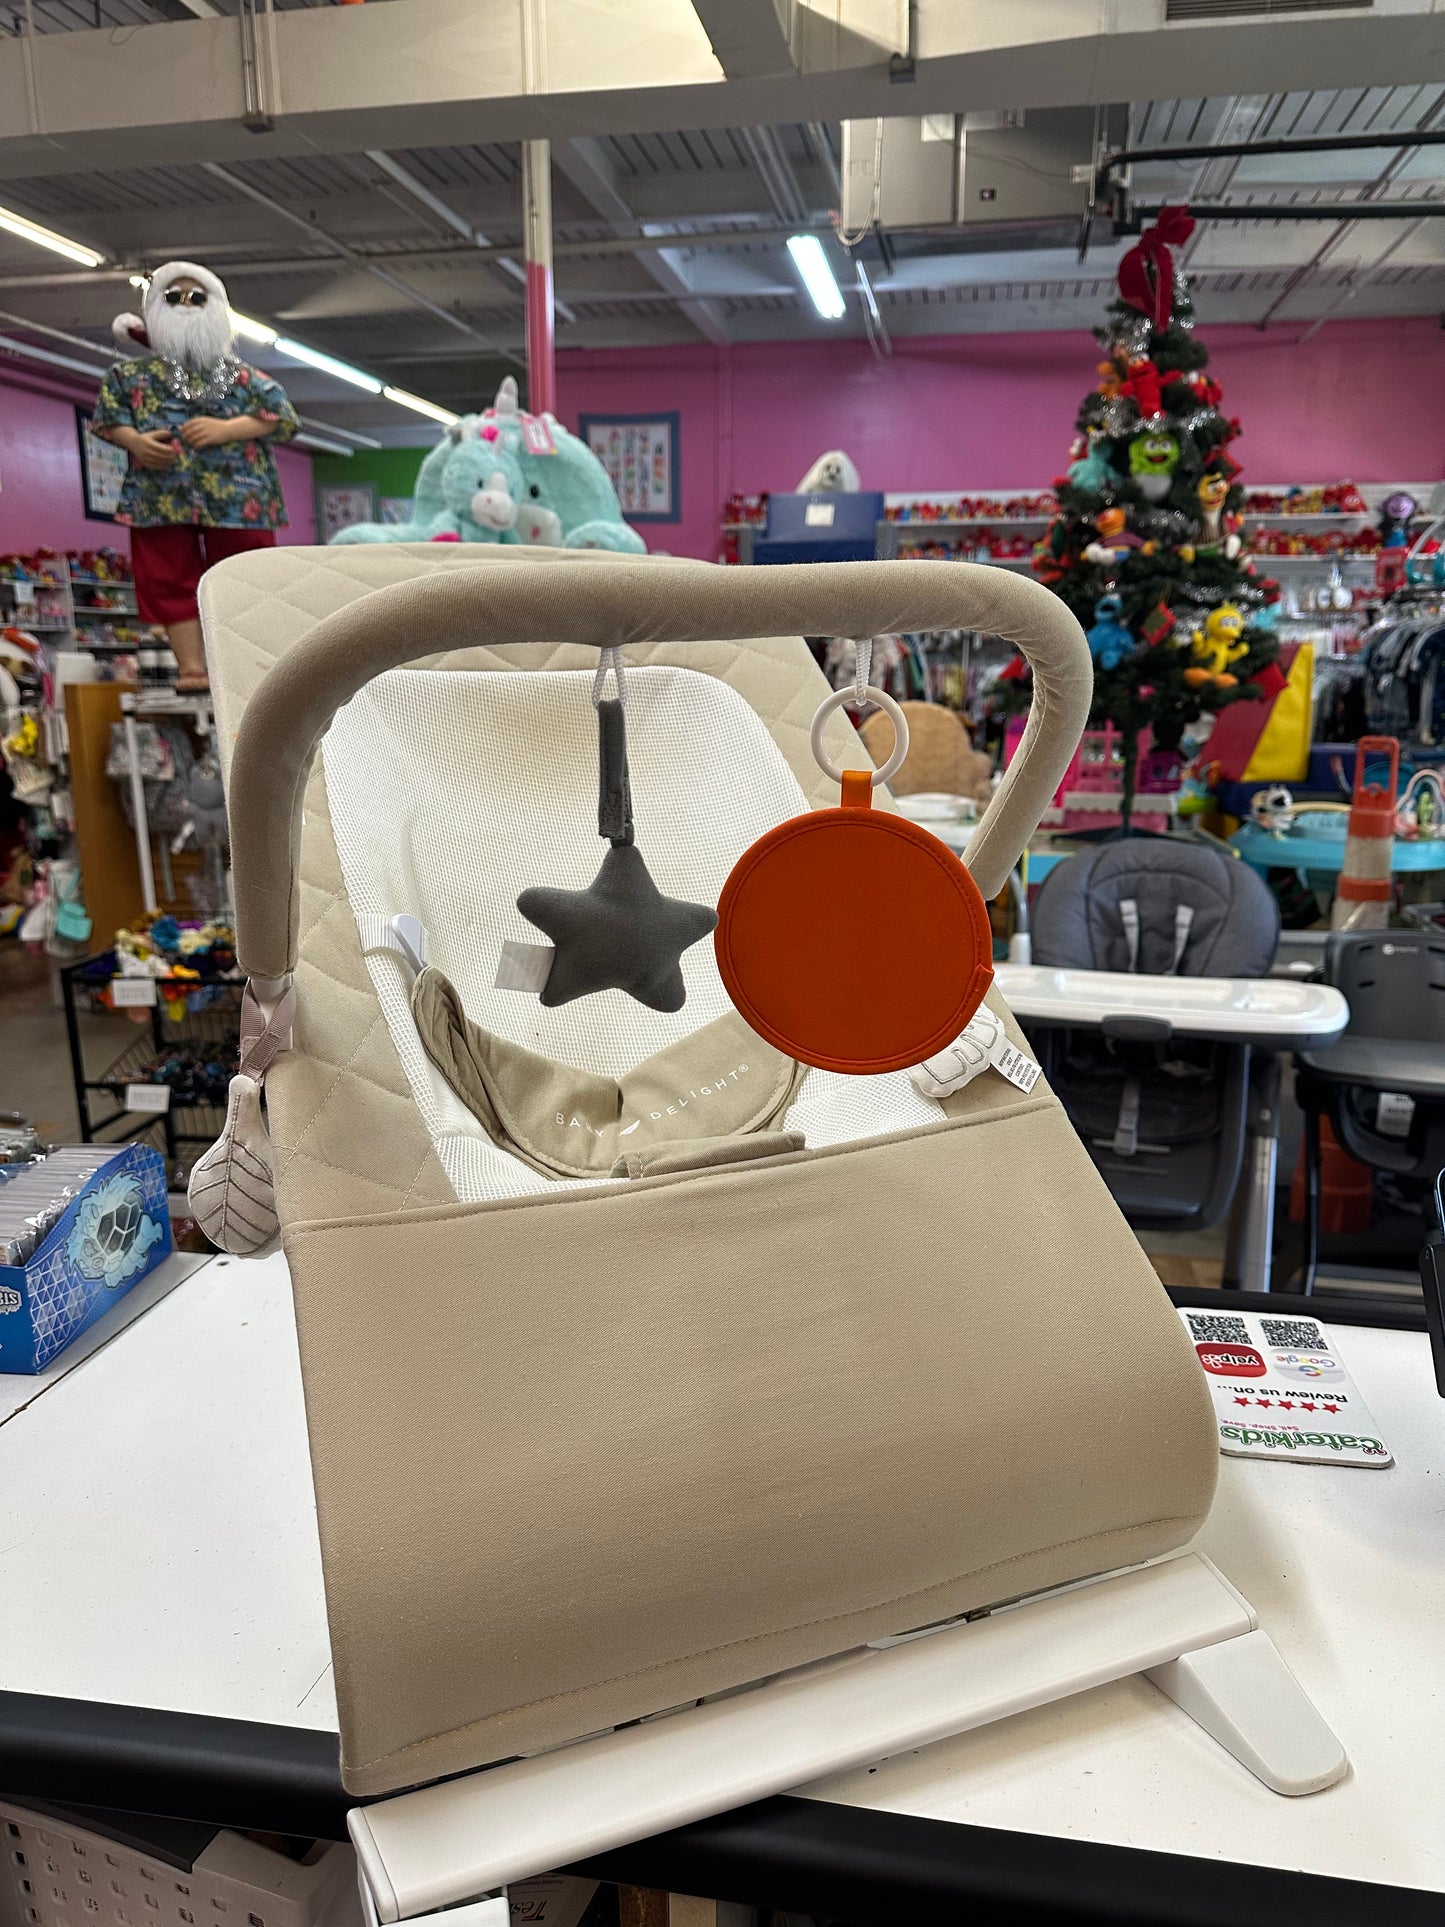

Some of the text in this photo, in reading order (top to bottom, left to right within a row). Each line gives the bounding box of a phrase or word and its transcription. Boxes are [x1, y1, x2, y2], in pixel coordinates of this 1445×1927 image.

[1219, 1353, 1259, 1366] yelp
[1276, 1355, 1336, 1368] Google
[1217, 1385, 1349, 1403] Review us on...
